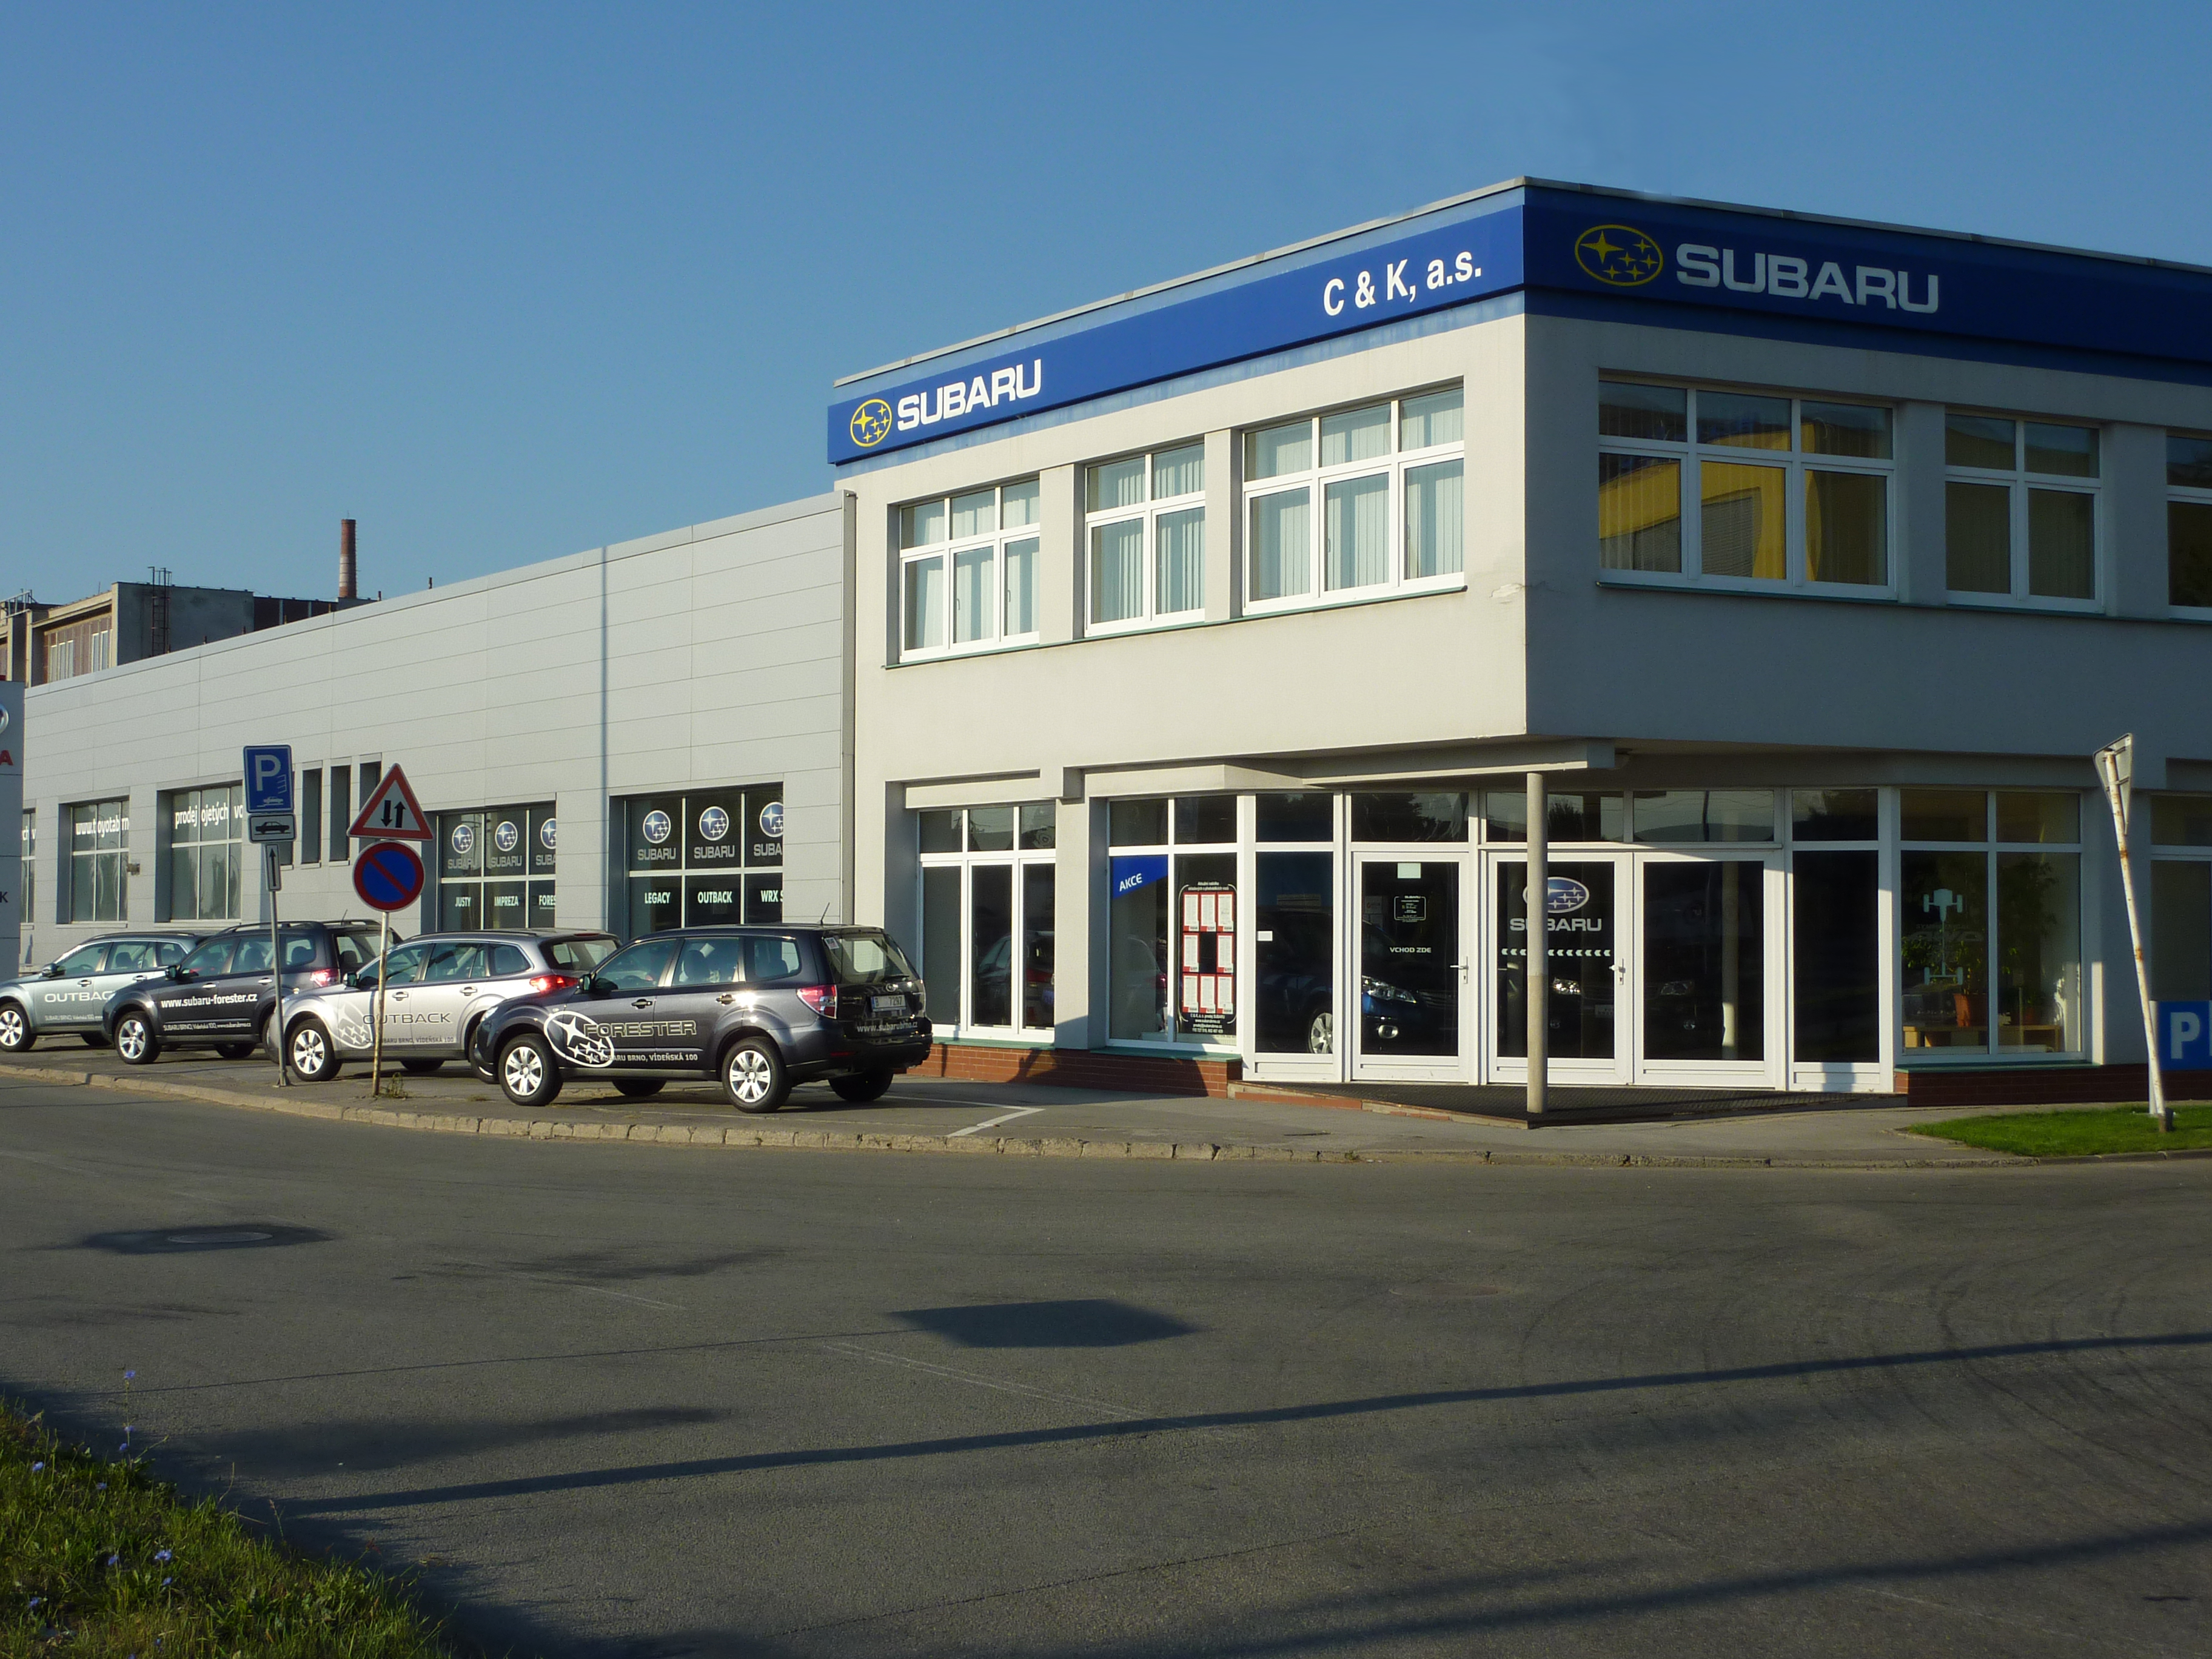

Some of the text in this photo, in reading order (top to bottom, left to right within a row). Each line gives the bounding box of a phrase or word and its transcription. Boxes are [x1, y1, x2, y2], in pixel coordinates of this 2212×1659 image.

[1324, 251, 1481, 316] C & K, a.s.
[1676, 243, 1939, 314] SUBARU
[897, 359, 1042, 431] SUBARU
[255, 754, 282, 791] P
[175, 804, 198, 830] prodej
[201, 802, 229, 827] ojetých
[638, 848, 677, 860] SUBARU
[694, 845, 735, 859] SUBARU
[753, 843, 783, 856] SUBA
[447, 858, 477, 869] SUBARU
[491, 856, 523, 867] SUBARU
[1119, 873, 1143, 892] AKCE
[455, 897, 471, 907] JUSTY
[494, 896, 519, 907] IMPREZA
[645, 892, 671, 904] LEGACY
[698, 891, 732, 903] OUTBACK
[760, 890, 779, 902] WRX
[1510, 918, 1602, 931] SBARU
[161, 993, 258, 1008] www.subaru-forester.cz
[584, 1021, 697, 1037] FORESTER
[857, 1020, 918, 1033] www.subarubrno.cz
[2170, 1012, 2200, 1059] P
[649, 1052, 684, 1061] VÍDEŇSKÁ
